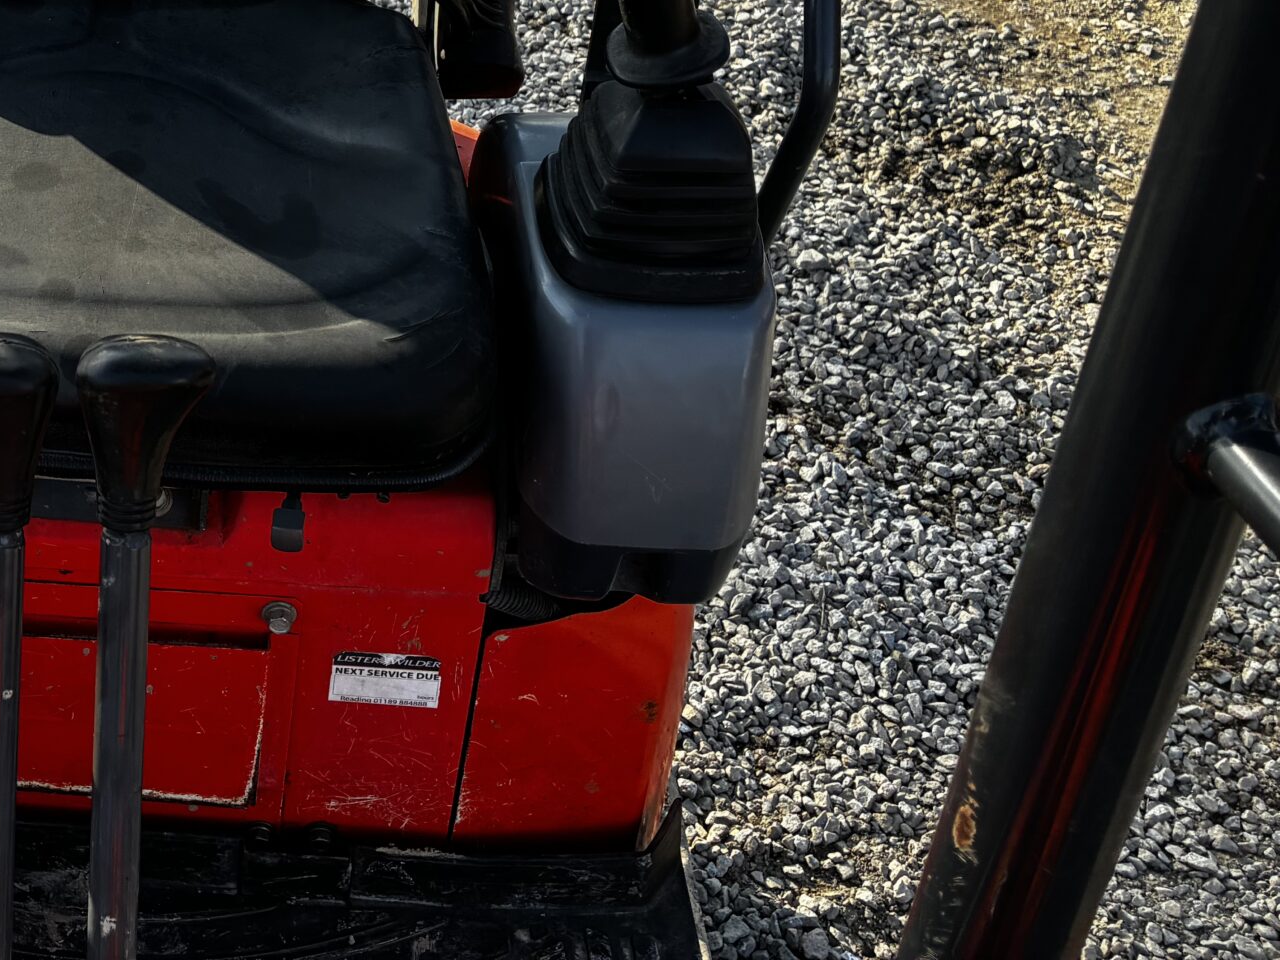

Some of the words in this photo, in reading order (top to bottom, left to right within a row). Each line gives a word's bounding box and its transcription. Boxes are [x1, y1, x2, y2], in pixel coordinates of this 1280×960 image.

[337, 655, 381, 664] LISTER
[335, 667, 365, 676] NEXT
[367, 670, 414, 679] SERVICE
[416, 673, 440, 681] DUE
[340, 695, 372, 704] Reading
